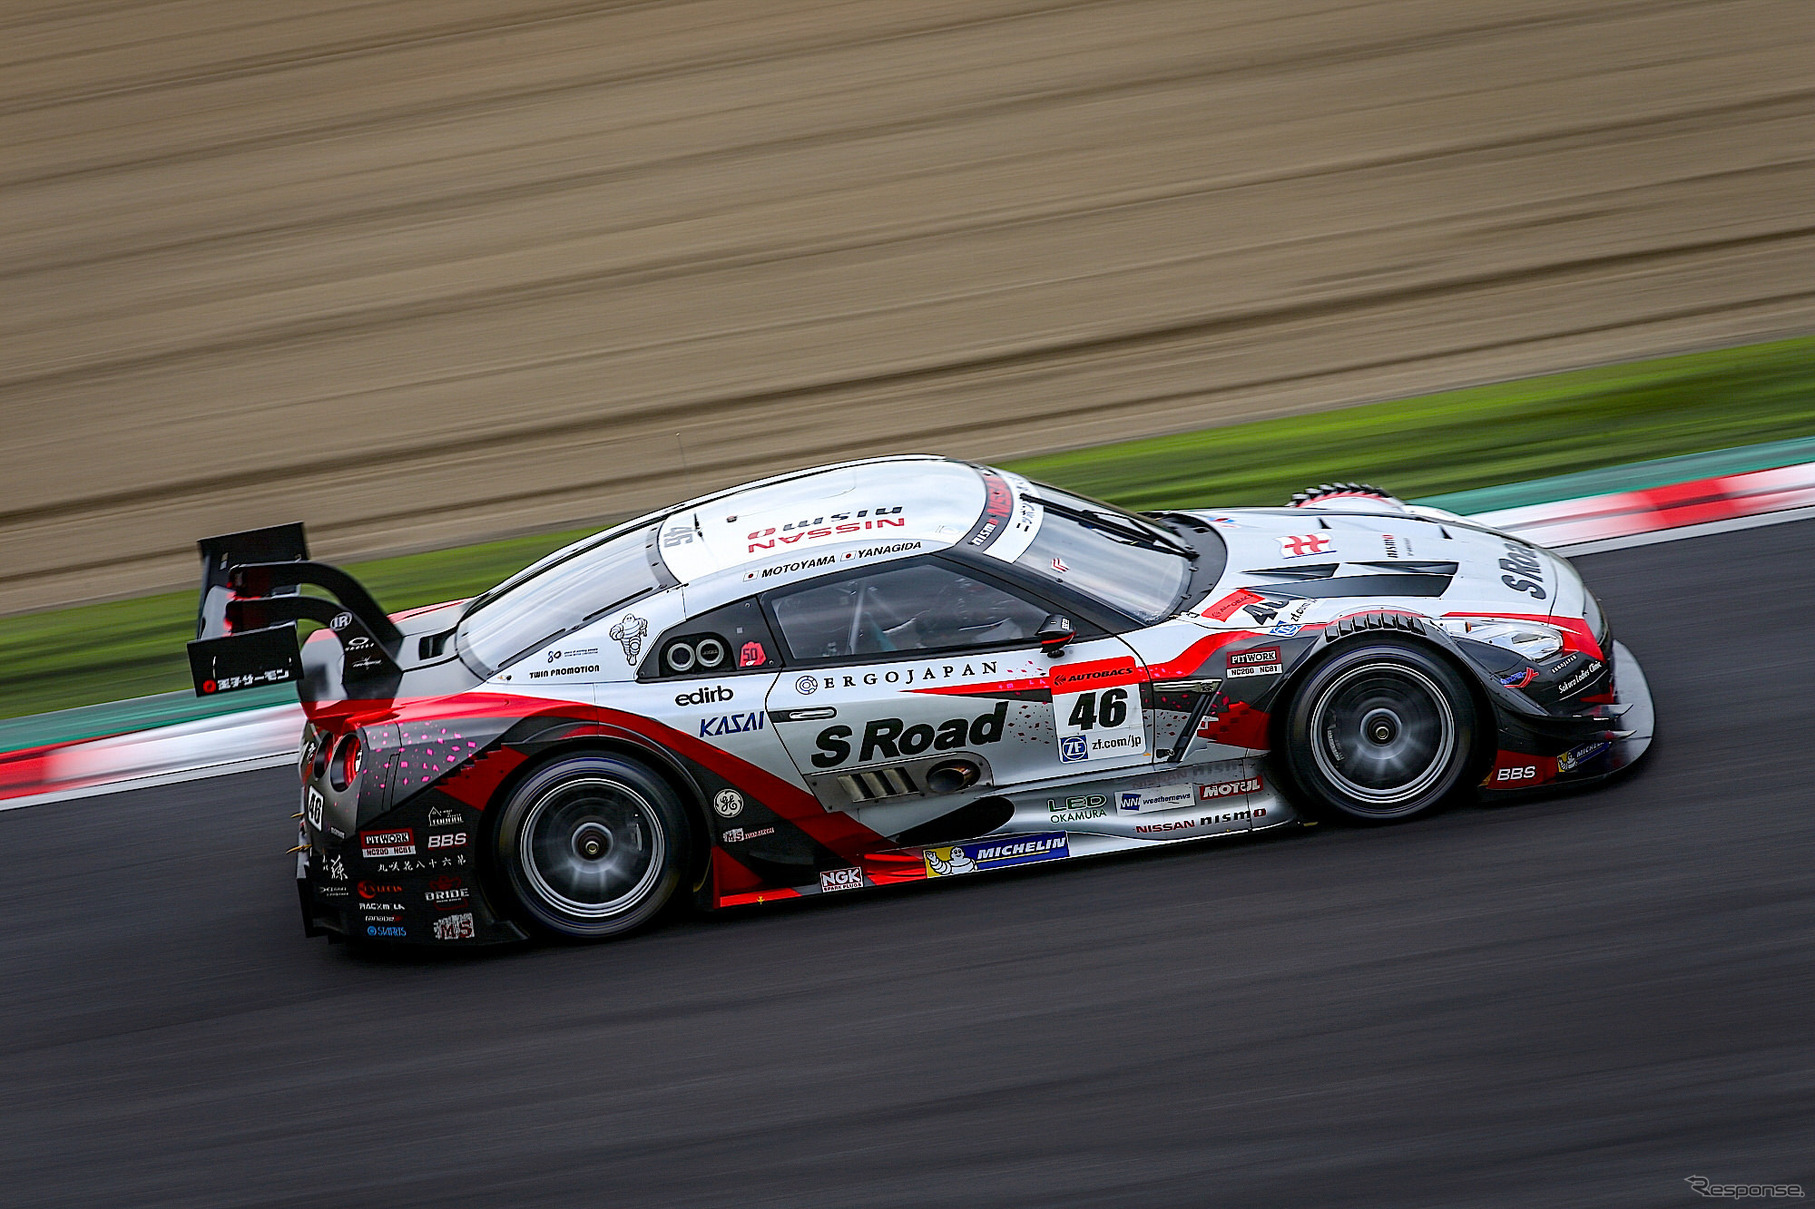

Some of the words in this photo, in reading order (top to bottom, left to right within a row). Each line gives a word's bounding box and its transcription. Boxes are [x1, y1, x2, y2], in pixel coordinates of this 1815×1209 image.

[748, 517, 905, 553] NISSAN
[971, 518, 999, 547] nismo
[761, 555, 836, 580] MOTOYAMA
[858, 541, 922, 559] YANAGIDA
[1501, 574, 1547, 600] S
[529, 670, 549, 679] TWIN
[550, 664, 600, 677] PROMOTION
[823, 661, 997, 689] ERGOJAPAN
[1068, 667, 1134, 682] AUTOBACS
[1231, 667, 1255, 676] NC200
[675, 685, 734, 707] edirb
[1068, 688, 1128, 731] 46
[699, 710, 765, 738] KASAI
[810, 724, 853, 769] S
[858, 701, 1009, 763] Road
[1091, 735, 1141, 750] zf.com/jp
[1497, 766, 1536, 781] BBS
[1142, 792, 1191, 806] weathernews
[1202, 778, 1261, 798] MOTUL
[309, 792, 322, 824] 46
[1048, 794, 1107, 812] LED
[1050, 808, 1107, 824] OKAMURA
[1135, 819, 1195, 833] NISSAN
[1200, 808, 1267, 826] nismo
[427, 833, 467, 849] BBS
[976, 837, 1066, 860] MICHELIN
[822, 868, 861, 887] NGK
